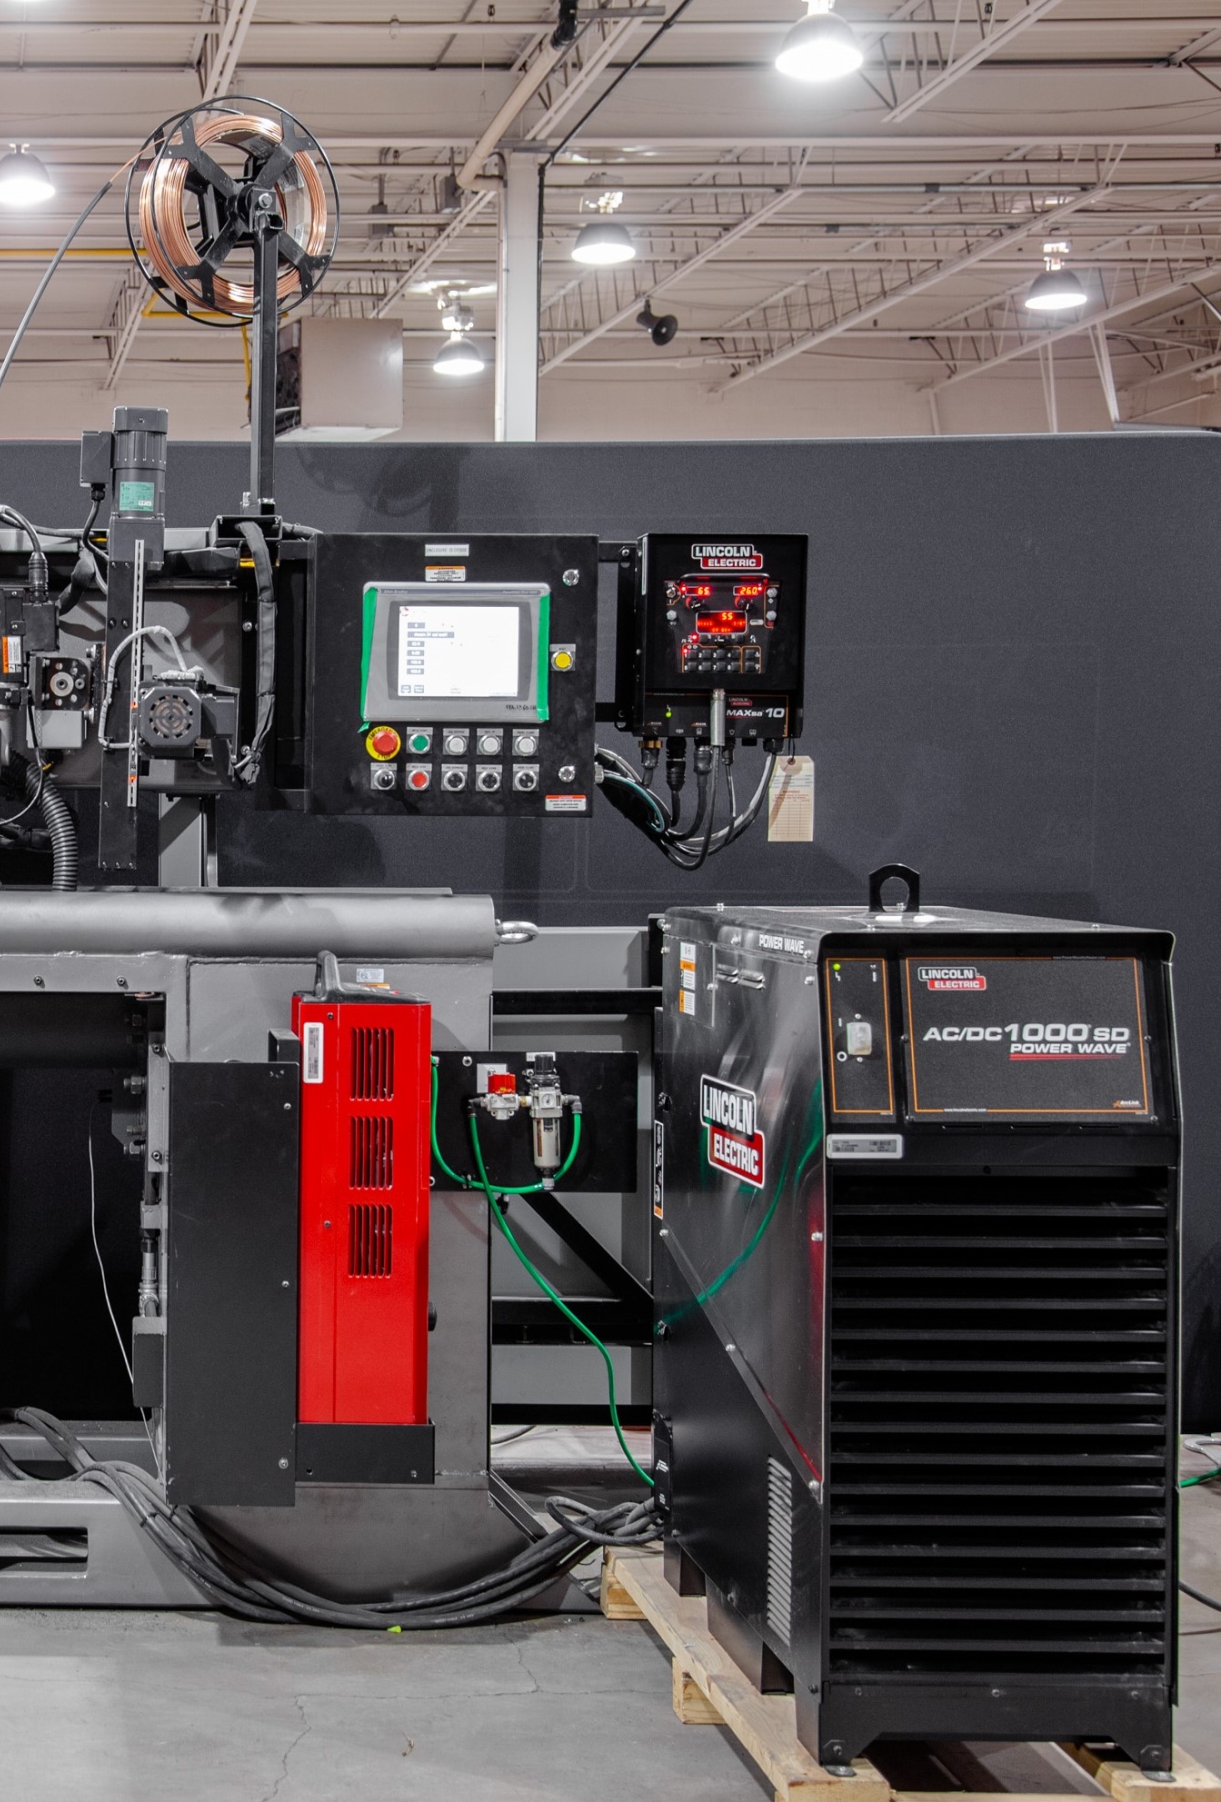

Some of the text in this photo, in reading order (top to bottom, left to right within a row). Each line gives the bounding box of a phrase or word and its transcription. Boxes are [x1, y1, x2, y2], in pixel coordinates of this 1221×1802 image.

[695, 546, 751, 557] LINCOLN
[707, 558, 757, 567] ELECTRIC
[697, 586, 710, 595] 65
[726, 708, 785, 718] MAXsa 10
[759, 933, 805, 954] POWER WAVE
[921, 969, 974, 979] LINCOLN
[934, 980, 980, 989] ELECTRIC
[922, 1023, 1130, 1042] AC/DC 1000 SD
[1009, 1043, 1128, 1054] POWER WAVE
[703, 1084, 754, 1136] LINCOLN
[713, 1132, 759, 1176] ELECTRIC
